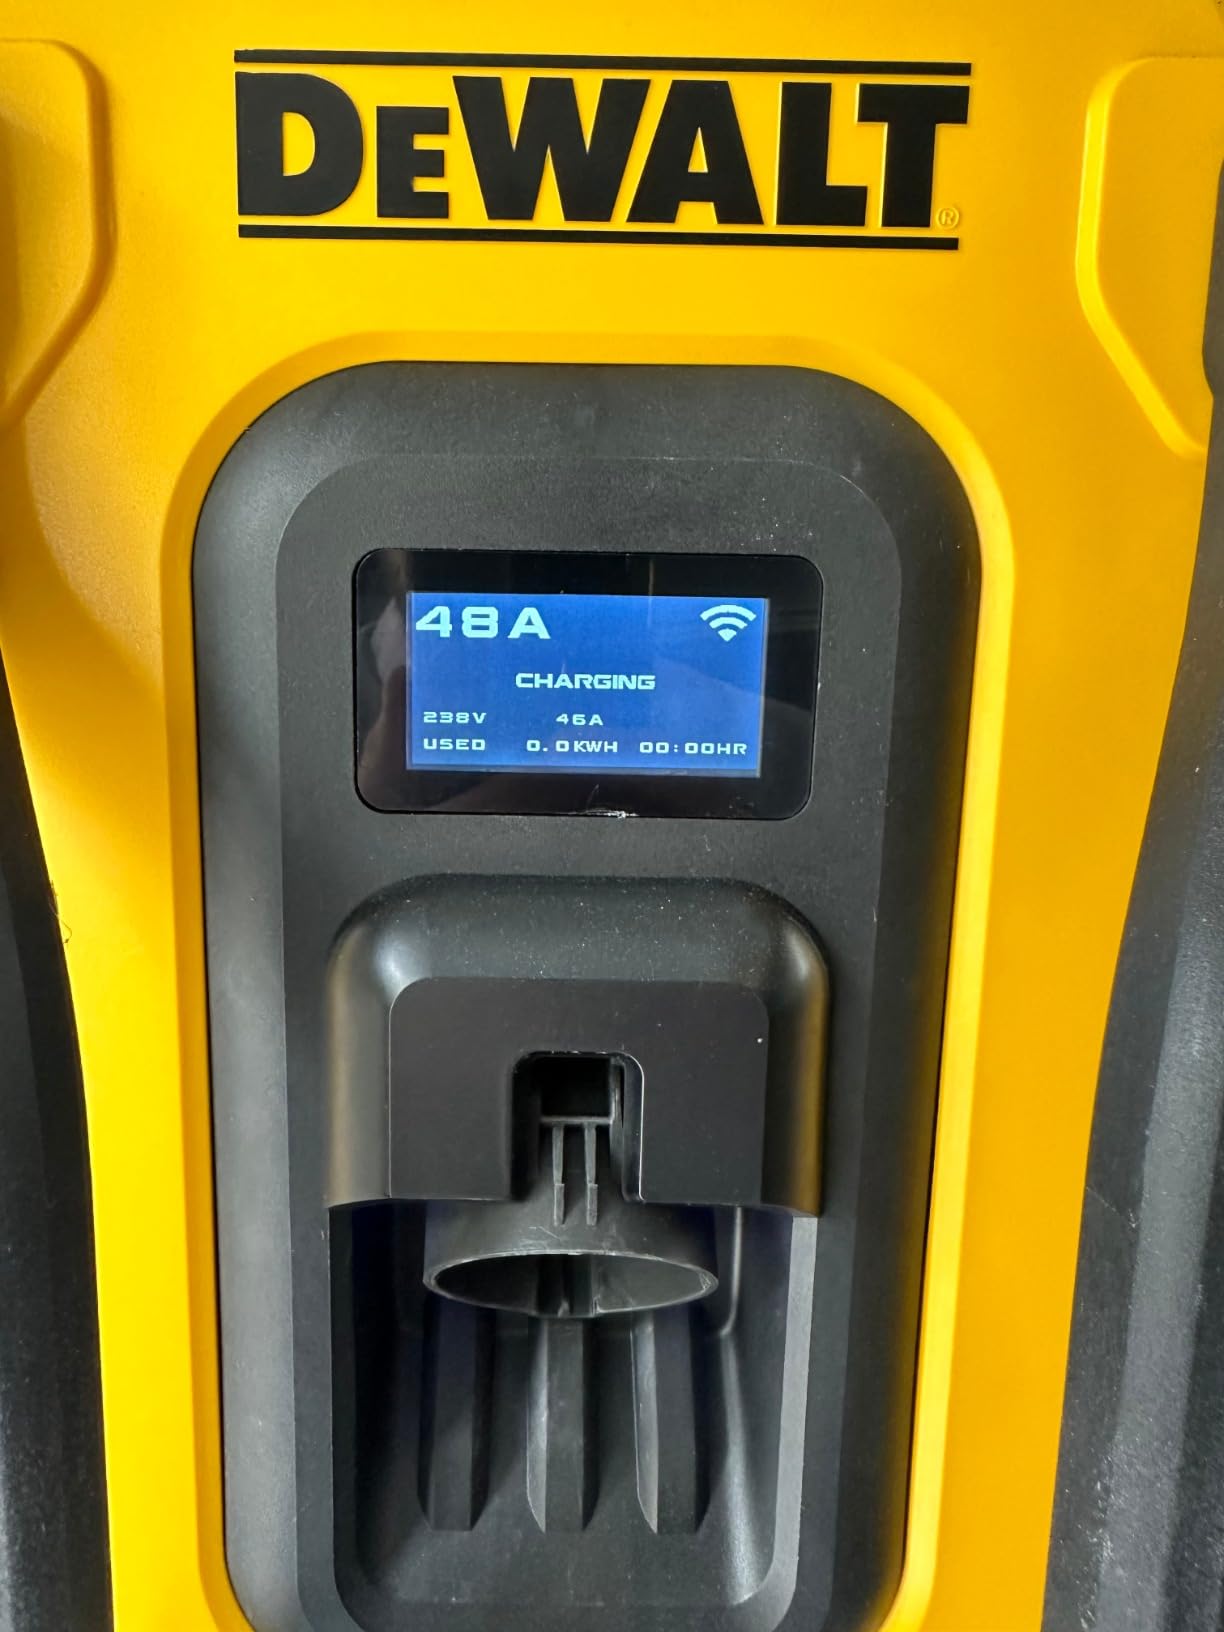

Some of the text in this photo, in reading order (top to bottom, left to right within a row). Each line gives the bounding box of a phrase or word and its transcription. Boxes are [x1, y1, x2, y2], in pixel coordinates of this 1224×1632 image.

[415, 605, 551, 640] 48A
[515, 672, 656, 690] CHARGING
[423, 711, 604, 726] 238V 46A
[423, 738, 486, 751] USED
[639, 741, 747, 755] 00:00HR
